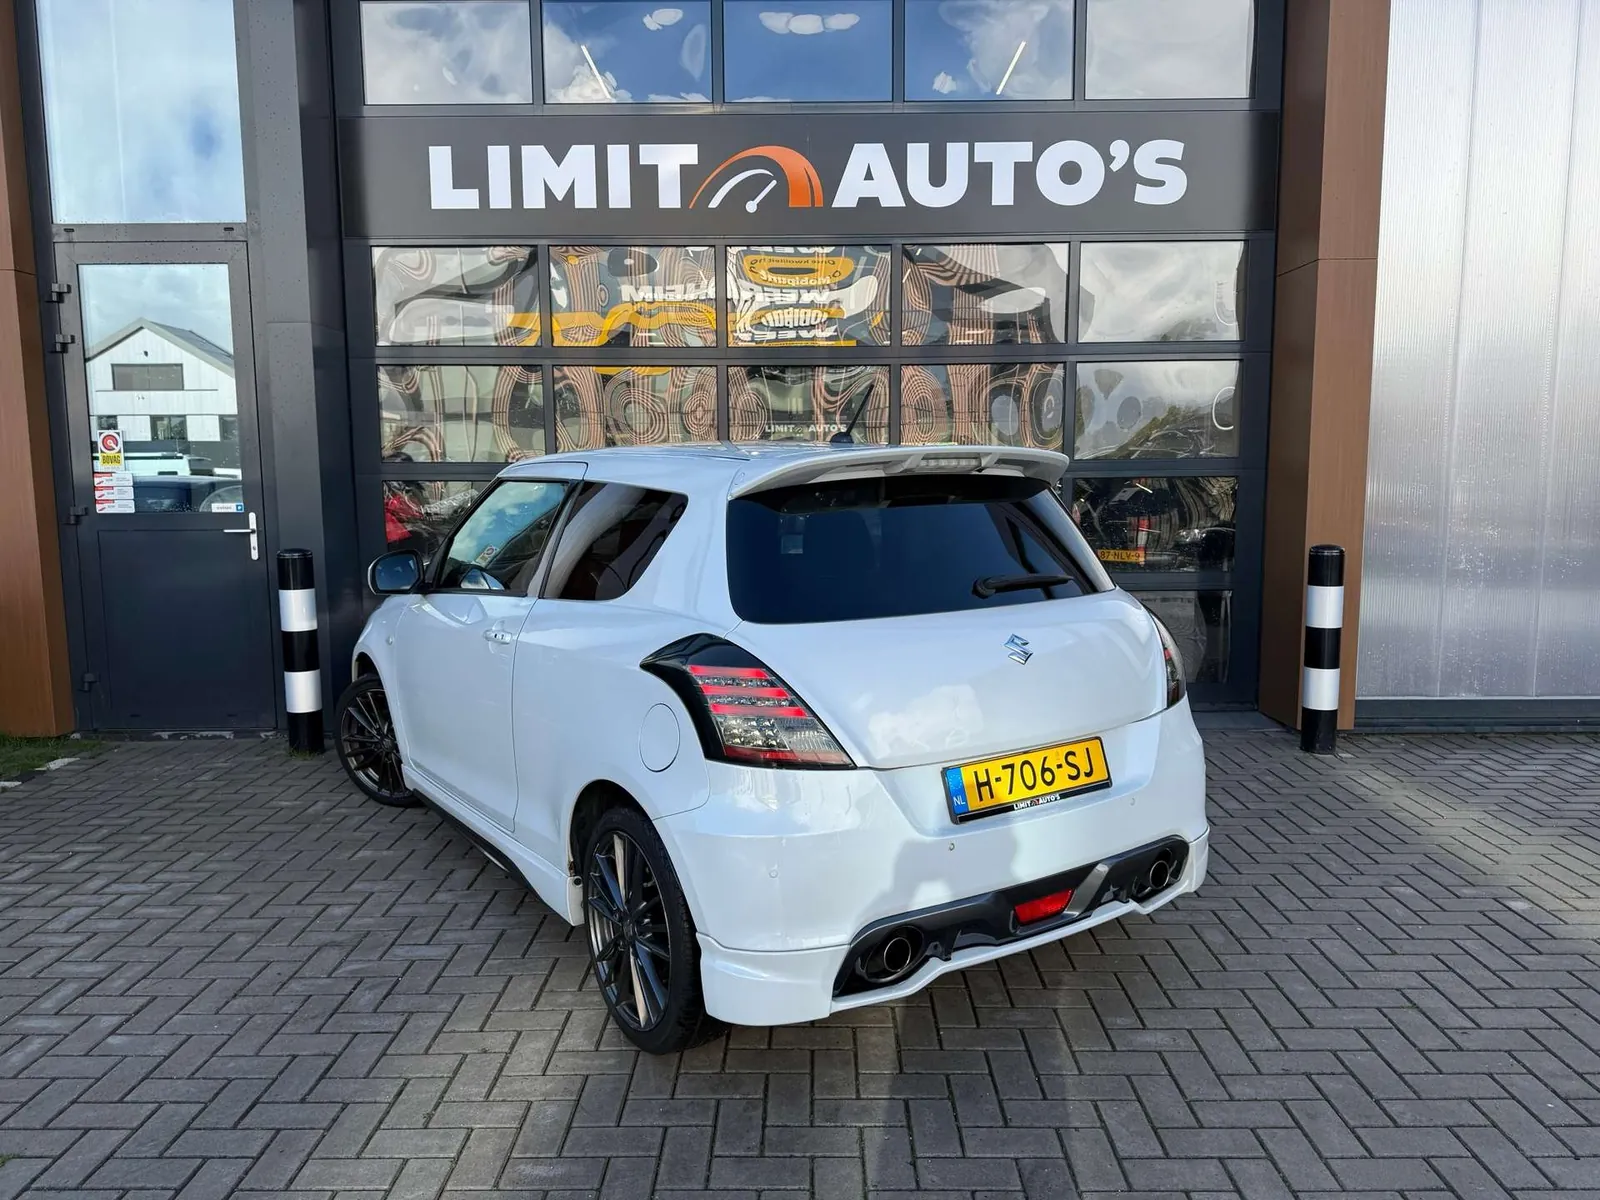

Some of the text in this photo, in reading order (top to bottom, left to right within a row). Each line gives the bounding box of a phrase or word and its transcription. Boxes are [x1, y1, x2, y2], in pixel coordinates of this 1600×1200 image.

[428, 138, 1188, 210] LIMIT AUTO'S
[765, 424, 795, 432] LIMIT
[101, 454, 121, 464] BOVAG
[1100, 550, 1141, 560] 87-NLV-9
[973, 747, 1095, 802] H-706-SJ
[953, 796, 966, 806] NL
[1013, 794, 1061, 811] LIMIT AUTO'S
